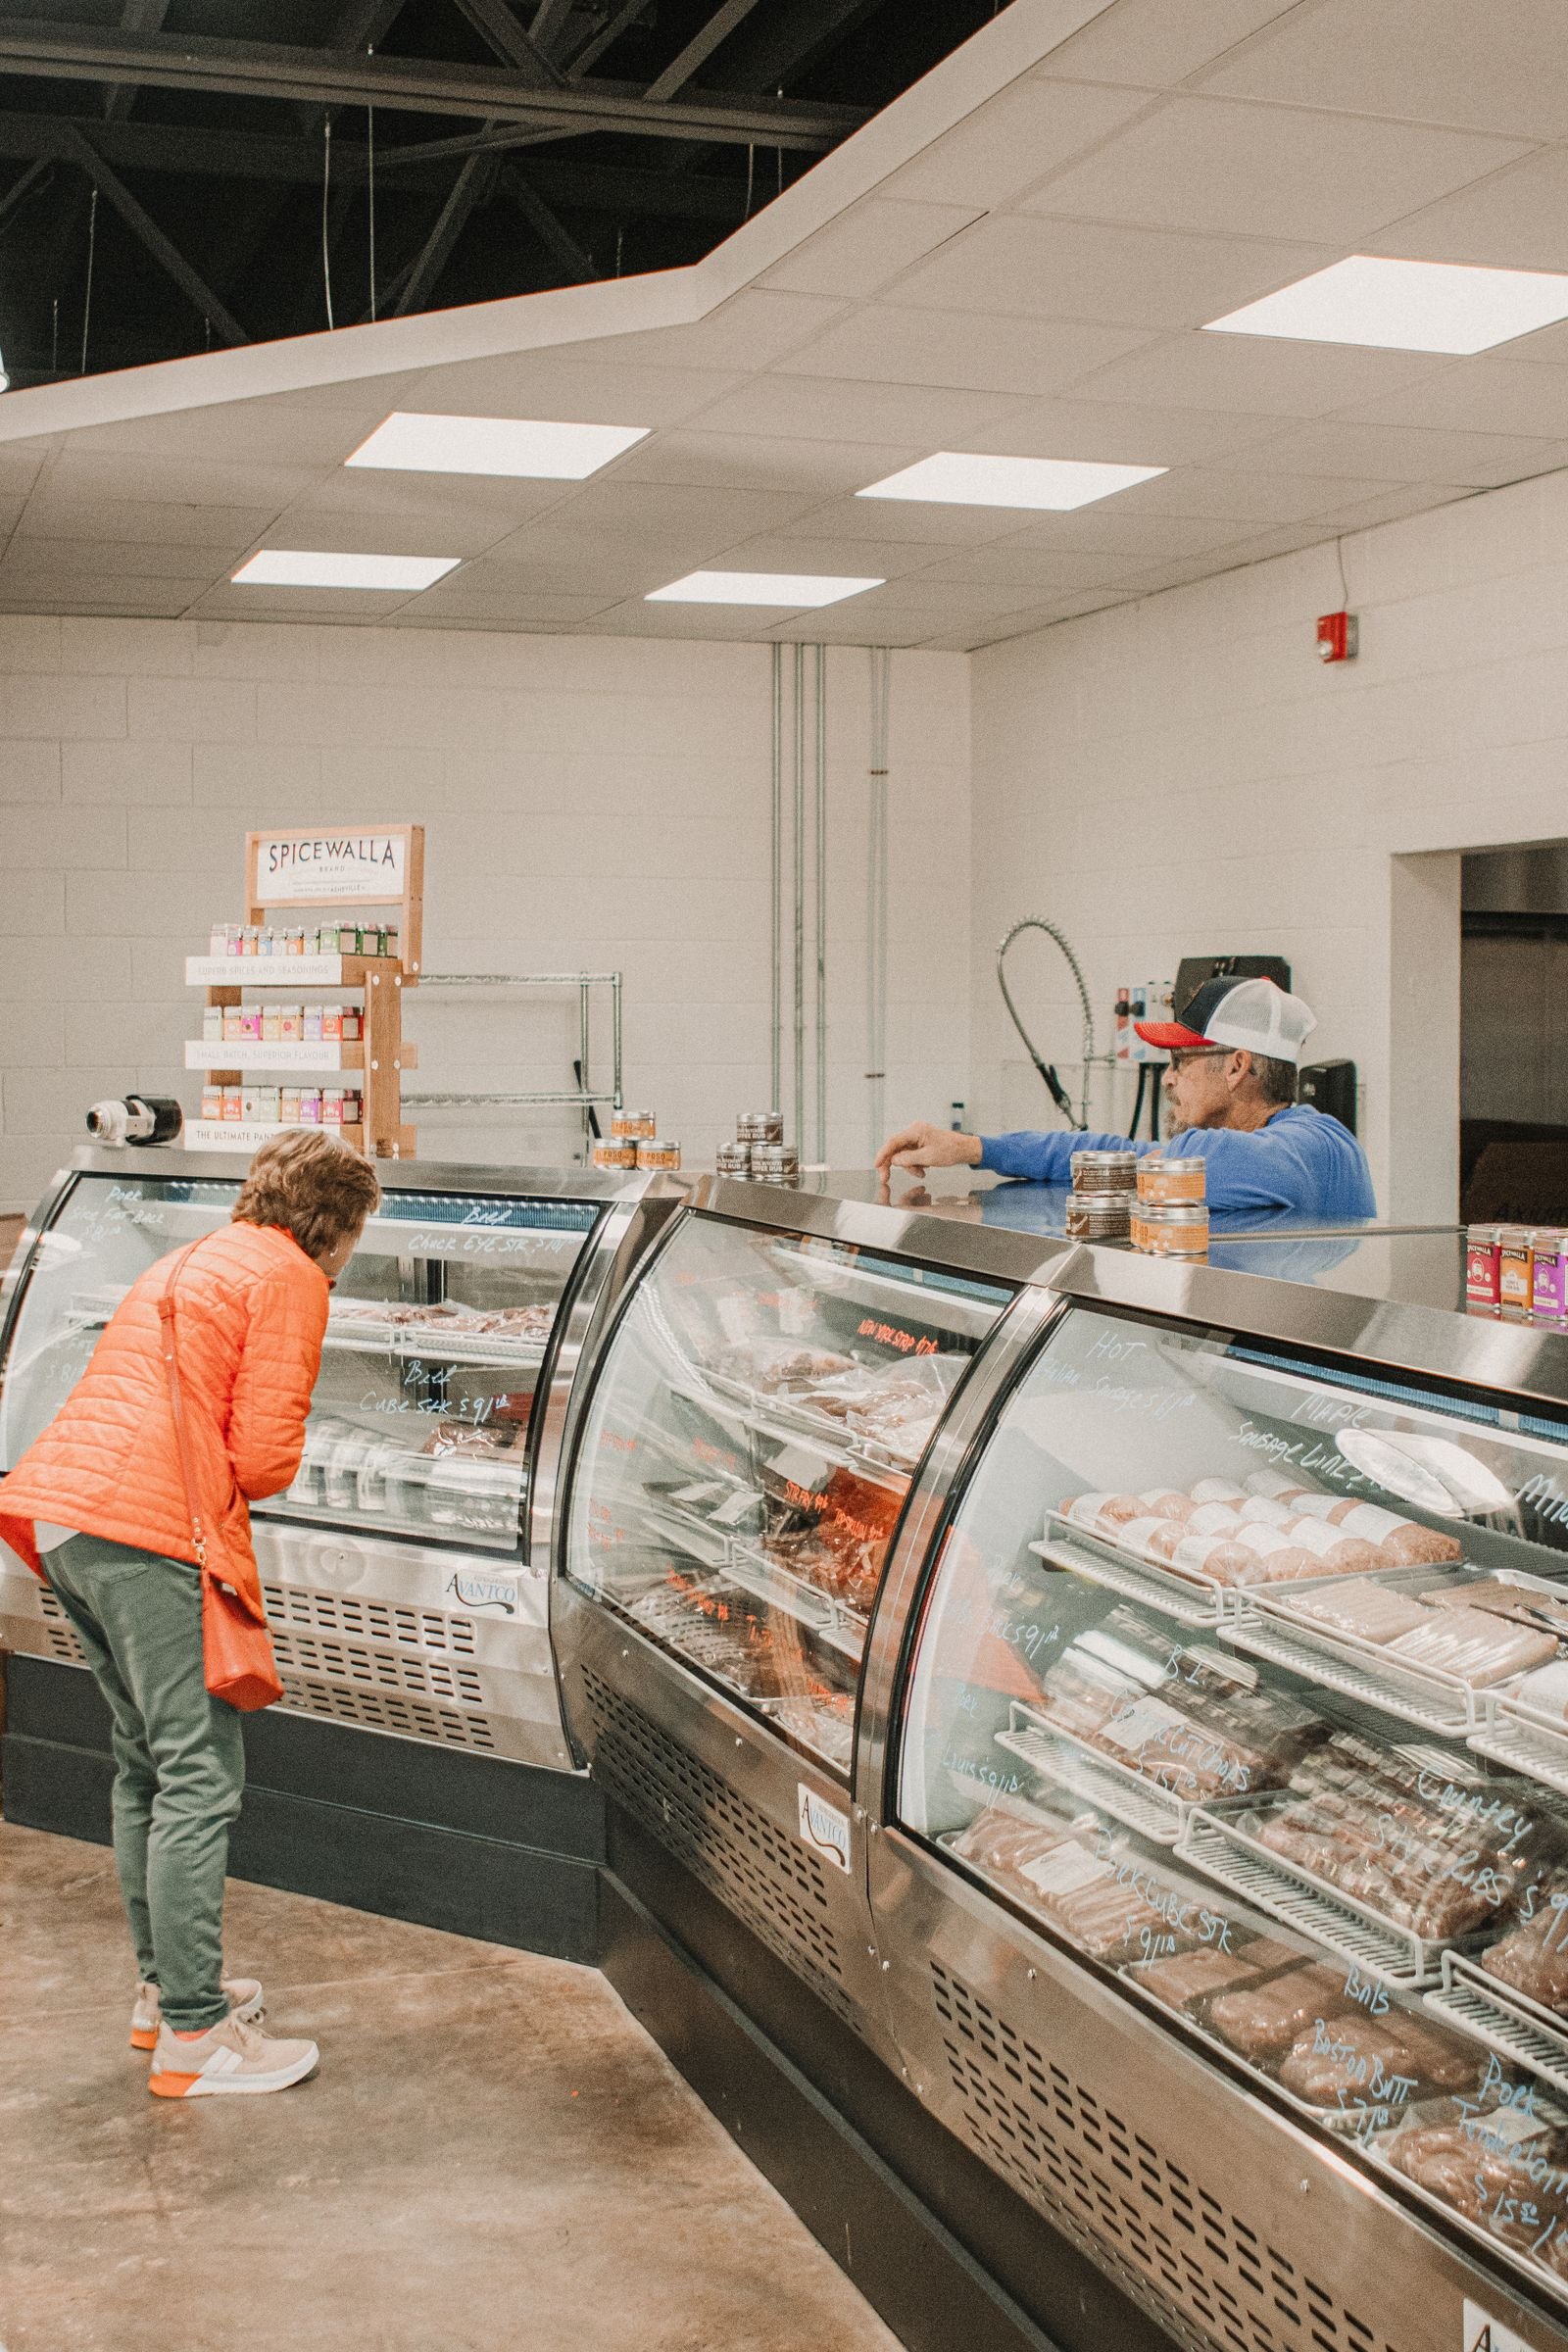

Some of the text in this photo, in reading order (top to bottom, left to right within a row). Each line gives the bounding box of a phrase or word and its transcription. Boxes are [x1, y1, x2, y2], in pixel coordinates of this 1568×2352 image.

[269, 839, 396, 872] SPICEWALLA
[258, 964, 274, 974] AND
[277, 964, 328, 974] SEASONINGS
[196, 1130, 211, 1140] THE
[214, 1131, 251, 1142] ULTIMATE
[445, 1573, 516, 1608] AVANTCO
